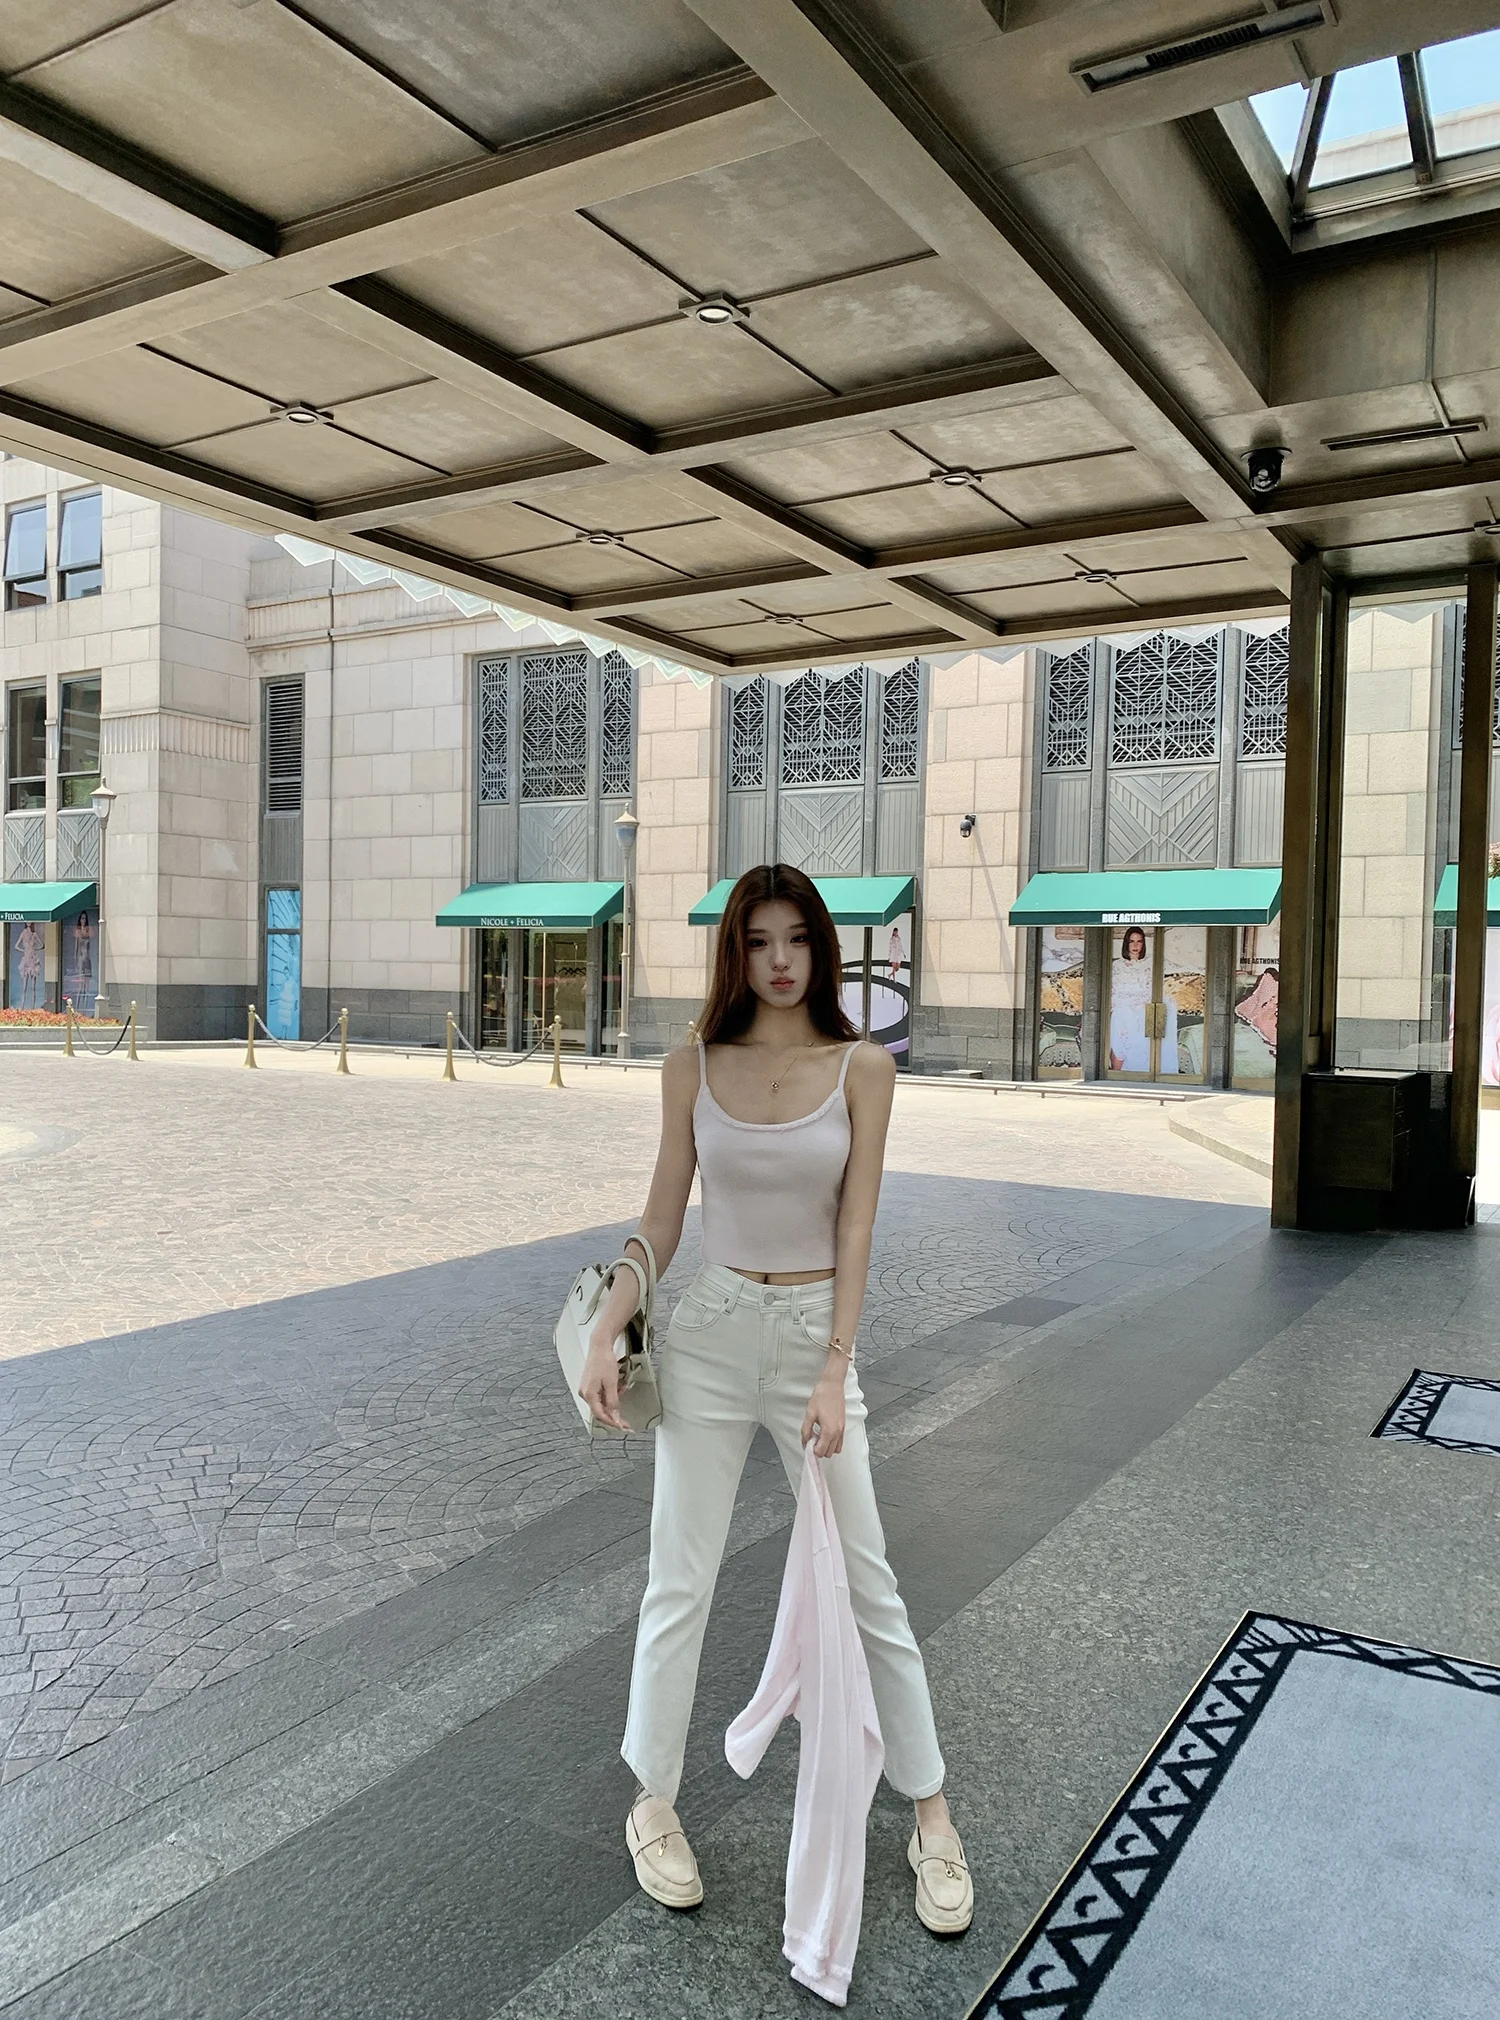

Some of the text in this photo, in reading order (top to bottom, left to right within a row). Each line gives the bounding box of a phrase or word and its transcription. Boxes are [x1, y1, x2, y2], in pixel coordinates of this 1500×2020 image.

[480, 917, 508, 926] NICOLE
[516, 917, 544, 926] FELICIA
[1118, 913, 1161, 923] AGTHONIS
